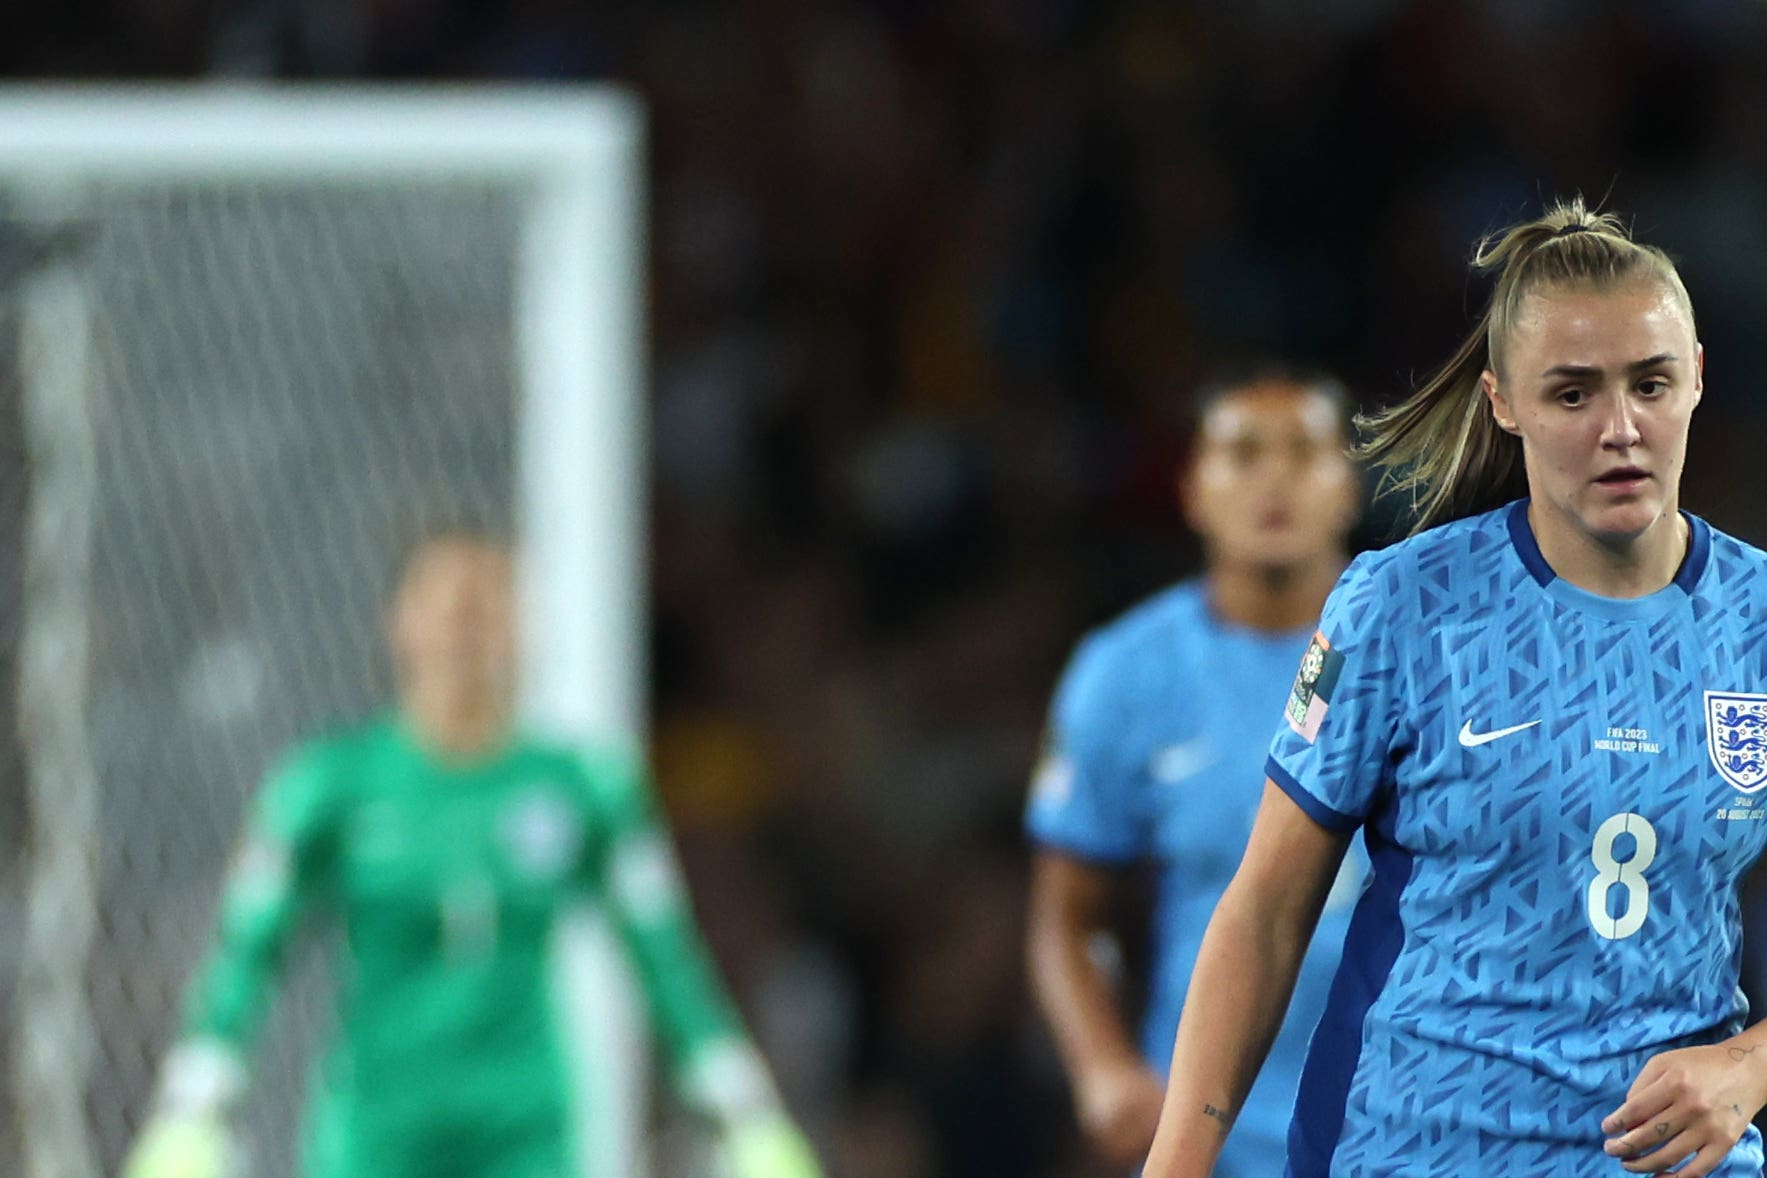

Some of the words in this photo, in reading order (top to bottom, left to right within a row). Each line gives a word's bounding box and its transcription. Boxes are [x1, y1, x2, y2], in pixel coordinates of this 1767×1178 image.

[1607, 727, 1623, 738] FIFA
[1625, 728, 1648, 740] 2023
[1594, 739, 1620, 751] WORLD
[1622, 741, 1637, 752] CUP
[1638, 742, 1660, 754] FINAL
[1588, 812, 1657, 940] 8
